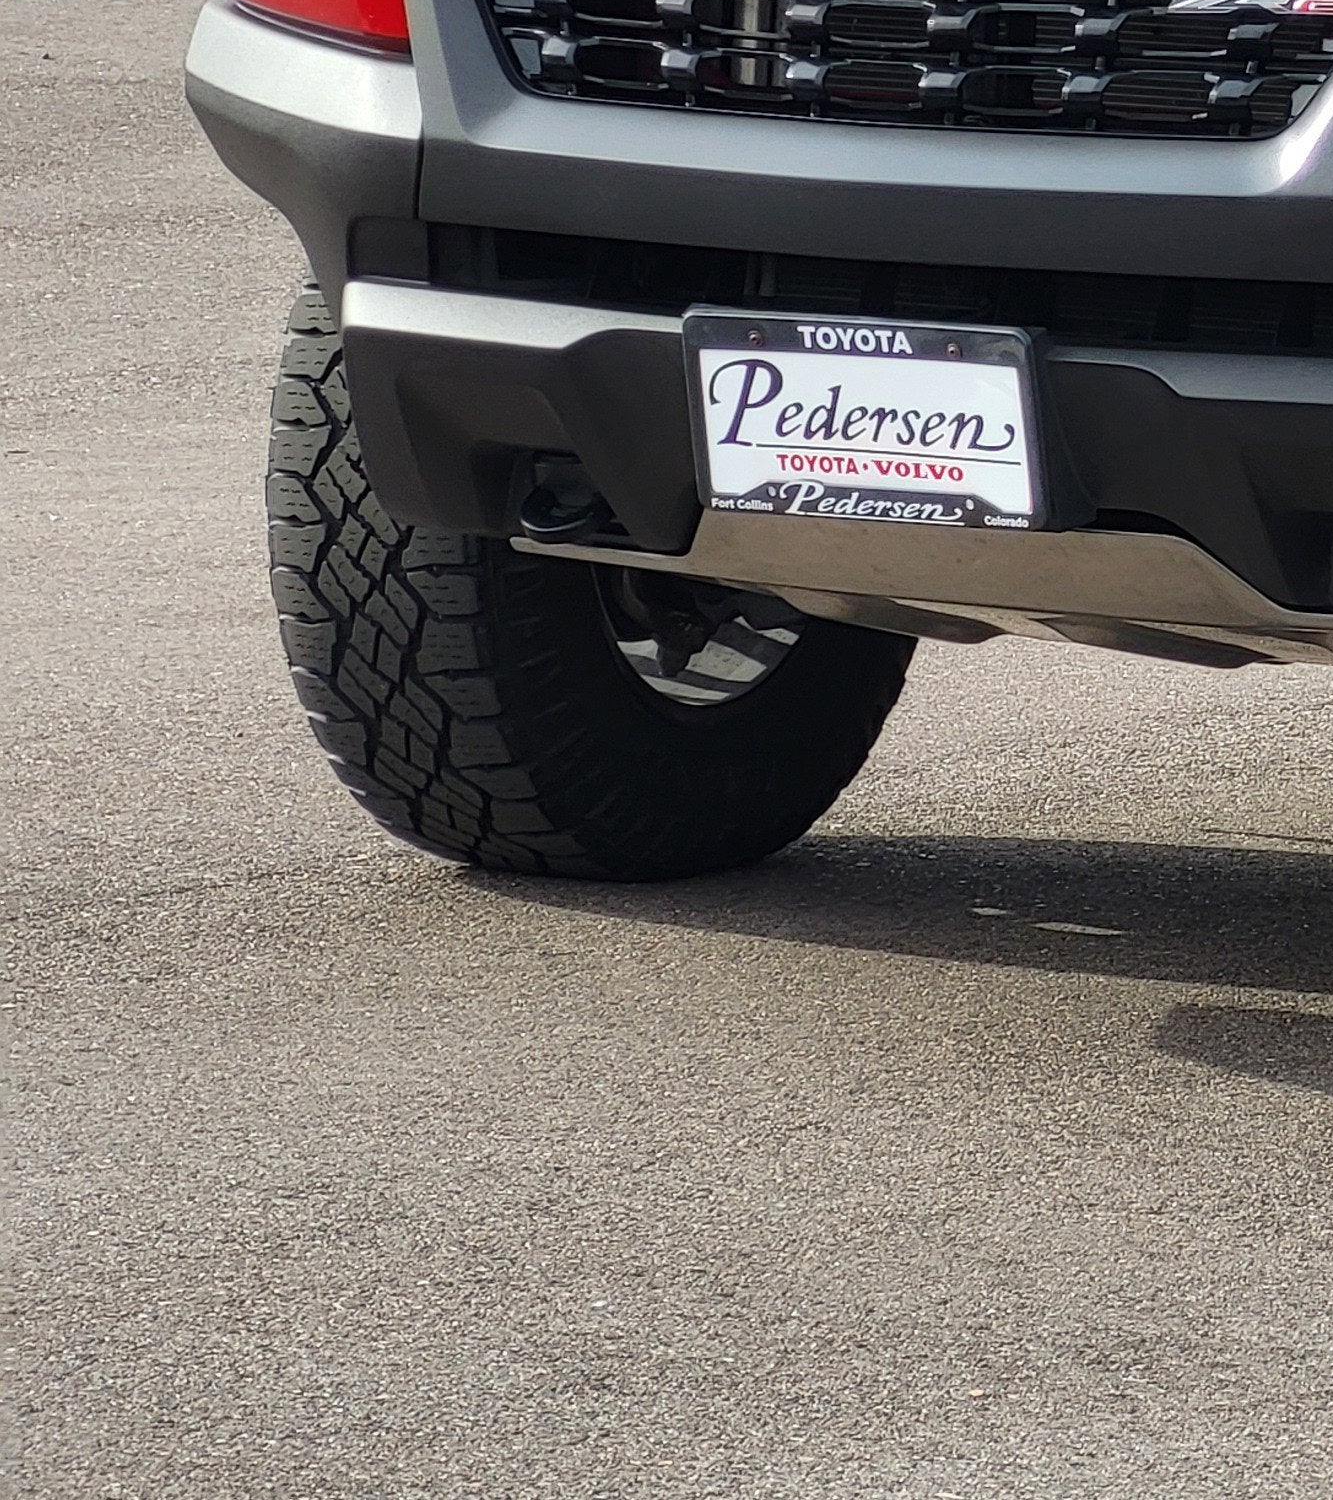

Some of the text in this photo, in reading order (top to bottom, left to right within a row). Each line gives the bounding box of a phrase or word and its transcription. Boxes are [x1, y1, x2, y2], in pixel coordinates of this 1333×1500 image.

[797, 326, 913, 355] TOYOTA
[709, 359, 1015, 451] Pedersen
[776, 454, 964, 482] TOYOTA VOLVO
[712, 497, 774, 512] Fort Collins
[779, 480, 963, 520] Pedersen
[983, 514, 1030, 528] Colorado
